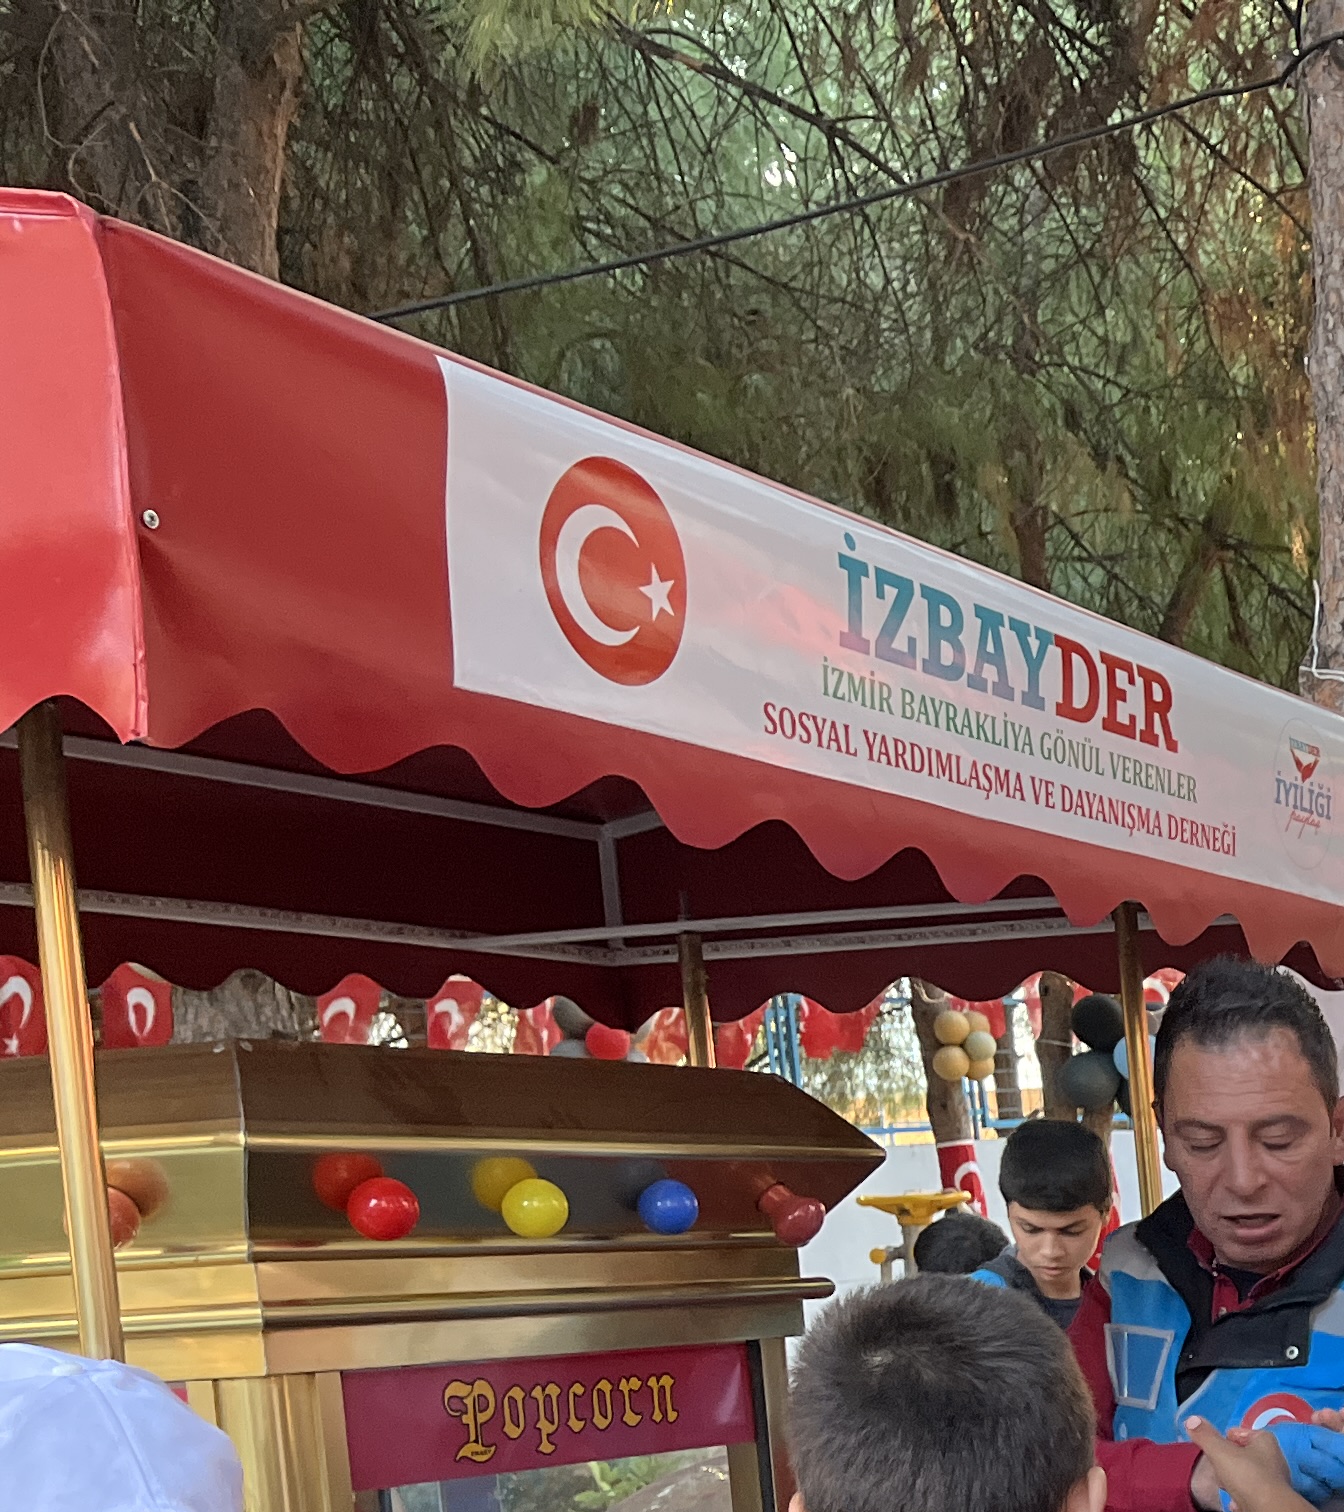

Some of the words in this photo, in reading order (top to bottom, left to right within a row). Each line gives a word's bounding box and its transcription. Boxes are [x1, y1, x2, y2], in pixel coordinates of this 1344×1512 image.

[837, 532, 1179, 753] İZBAYDER
[763, 701, 858, 758] SOSYAL
[862, 728, 1027, 802] YARDIMLAŞMA
[1030, 775, 1056, 810] VE
[1060, 783, 1163, 838] DAYANIŞMA
[1167, 813, 1237, 857] DERNEĞİ
[822, 656, 895, 716] İZMİR
[900, 687, 1035, 757] BAYRAKLİYA
[1039, 728, 1105, 777] GÖNÜL
[1109, 750, 1198, 803] VERENLER
[1274, 770, 1332, 820] İYİLİĞİ
[443, 1372, 679, 1463] Popcorn
